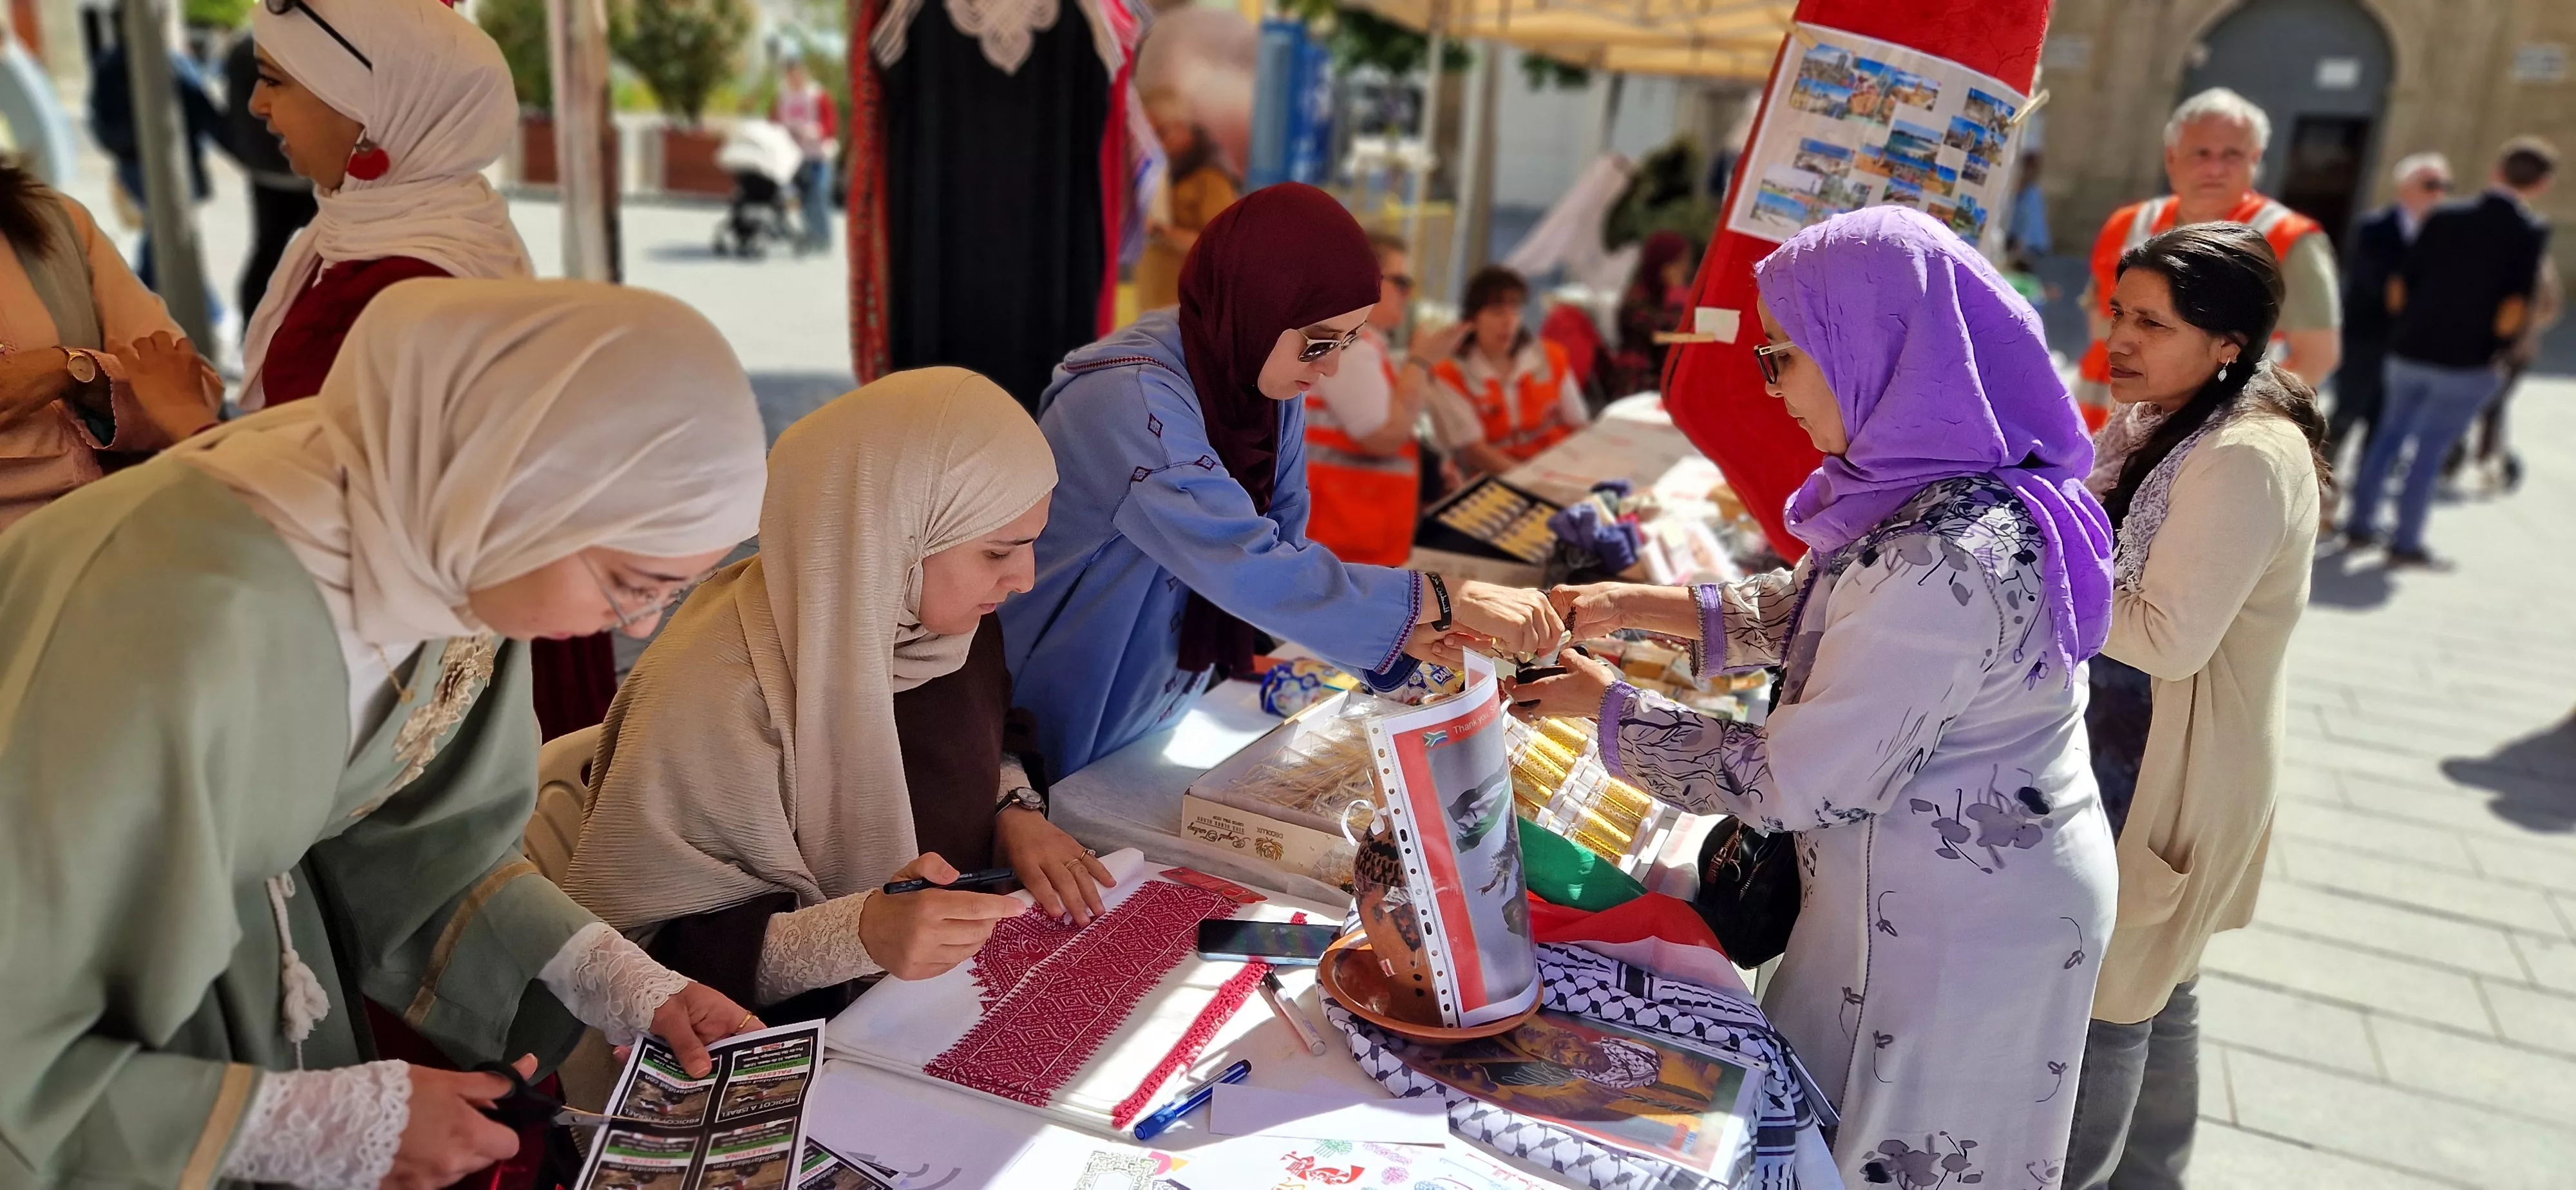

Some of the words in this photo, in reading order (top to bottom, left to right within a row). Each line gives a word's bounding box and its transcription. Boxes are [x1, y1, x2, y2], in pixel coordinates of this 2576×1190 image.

[1436, 587, 1450, 614] فلسطين
[1452, 719, 1477, 734] Thank
[1256, 827, 1283, 839] DECOLUX
[1217, 831, 1251, 849] Royal
[645, 1075, 659, 1084] con
[655, 1071, 698, 1089] PALESTINA
[747, 1069, 792, 1079] PALESTINA
[752, 1074, 799, 1084] Solidaridad
[659, 1082, 704, 1095] Solidaridad
[758, 1097, 796, 1108] #BOICOT
[624, 1108, 651, 1121] ISRAEL
[721, 1107, 748, 1117] ISRAEL
[724, 1146, 773, 1160] PALESTINA
[621, 1157, 671, 1166] PALESTINA
[731, 1153, 781, 1167] Solidaridad
[627, 1165, 678, 1173] Solidaridad
[801, 1166, 838, 1189] Solidaridad
